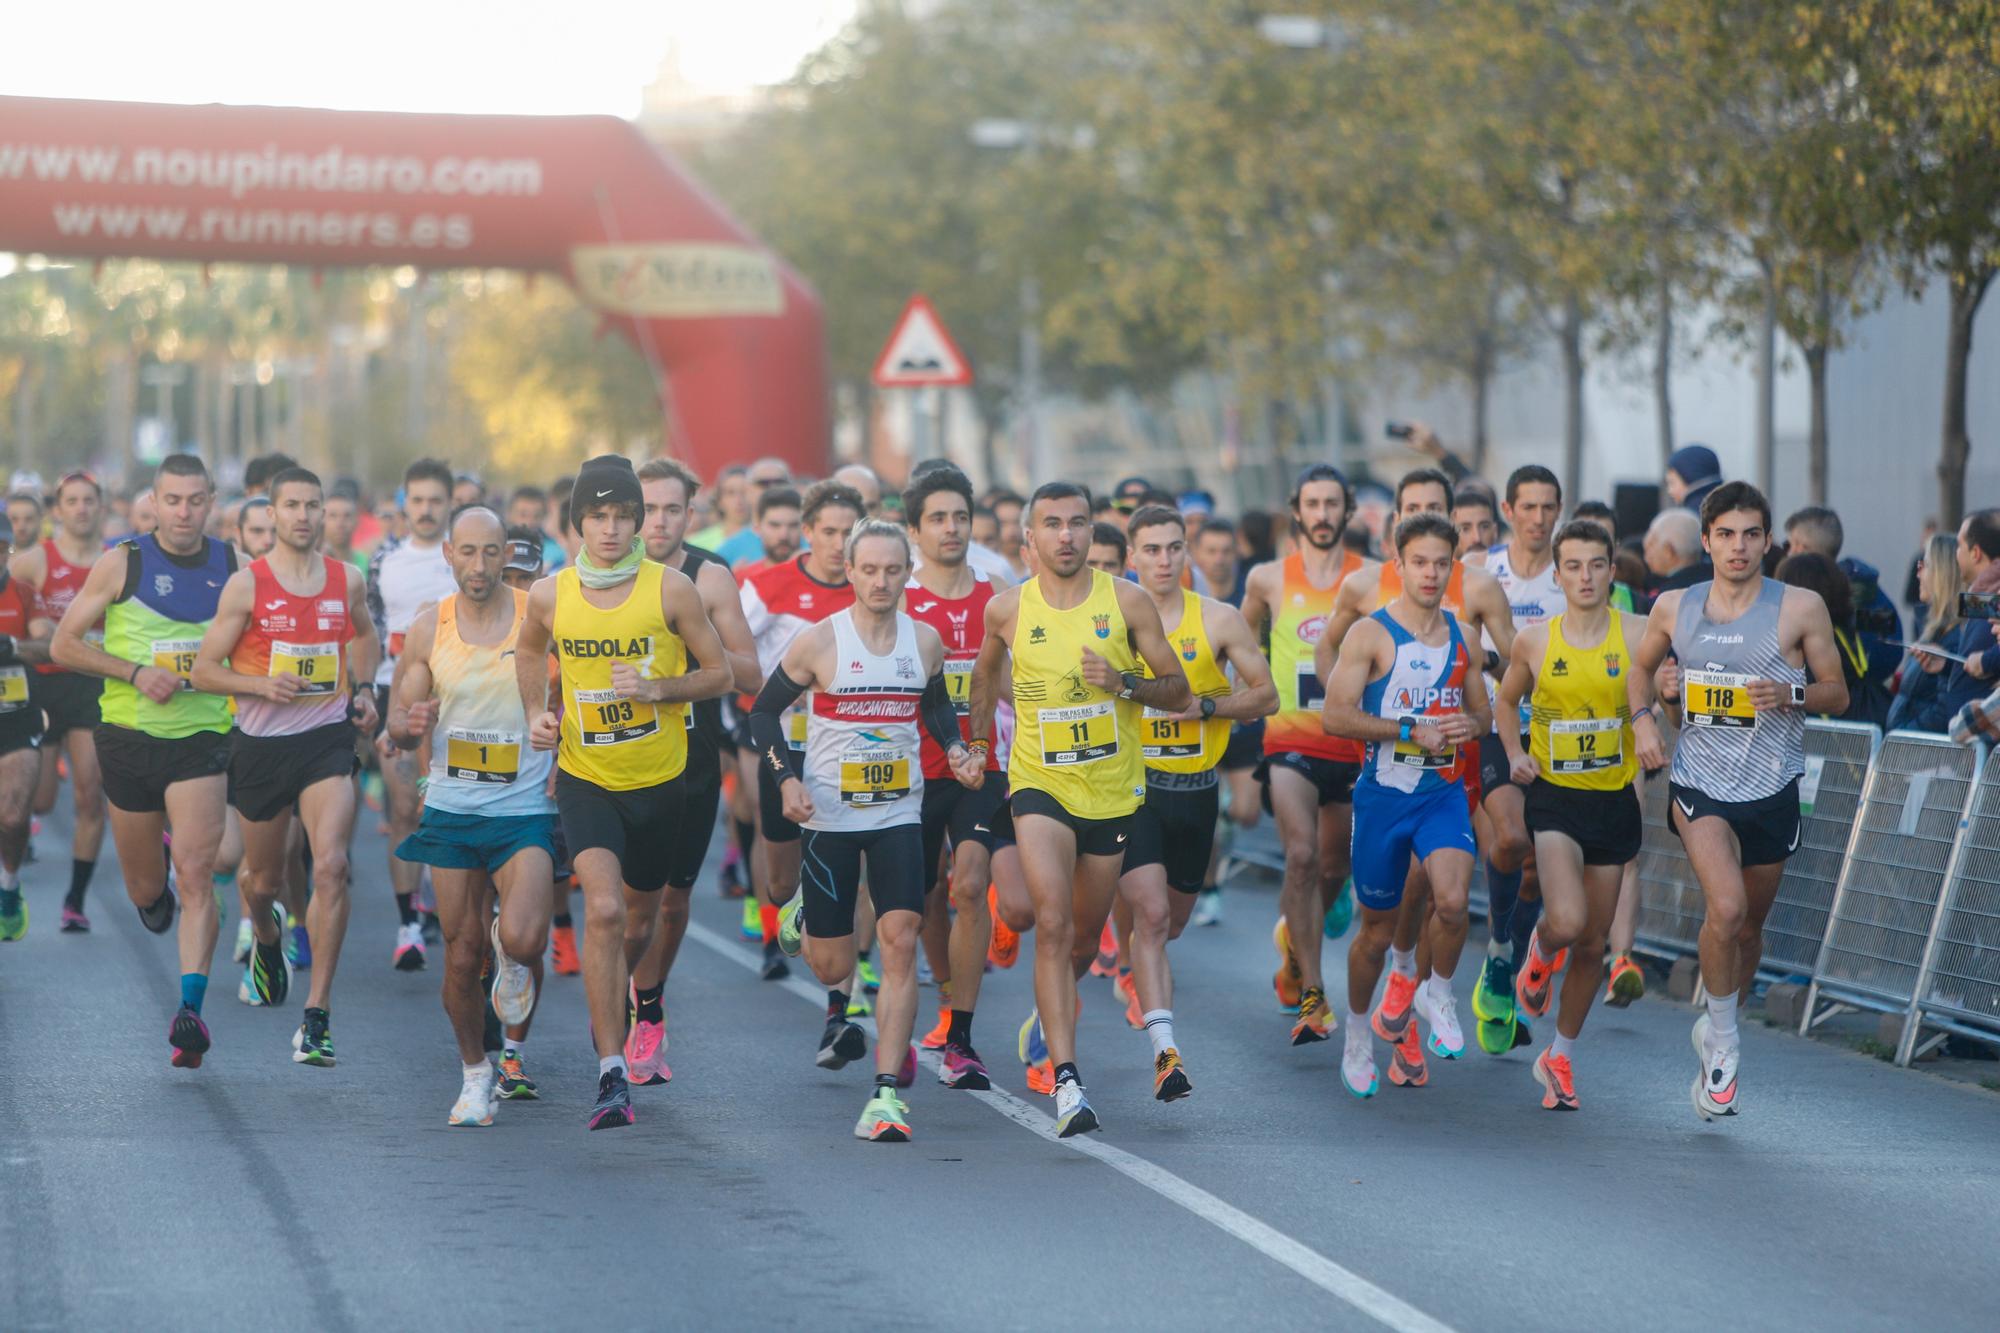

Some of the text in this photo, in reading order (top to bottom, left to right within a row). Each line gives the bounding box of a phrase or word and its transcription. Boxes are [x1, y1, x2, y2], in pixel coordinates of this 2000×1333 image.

[53, 203, 473, 249] www.runners.es
[562, 637, 649, 657] REDOLAT
[174, 654, 196, 673] 15
[296, 658, 315, 677] 16
[954, 675, 963, 694] 7
[1392, 687, 1463, 709] ALPES
[1704, 688, 1734, 708] 118
[597, 702, 634, 725] 103
[1070, 708, 1081, 716] PAS
[1081, 707, 1093, 715] RAS
[1069, 722, 1089, 742] 11
[1151, 720, 1180, 738] 151
[1576, 734, 1596, 753] 12
[478, 746, 487, 765] 1
[861, 764, 893, 784] 109
